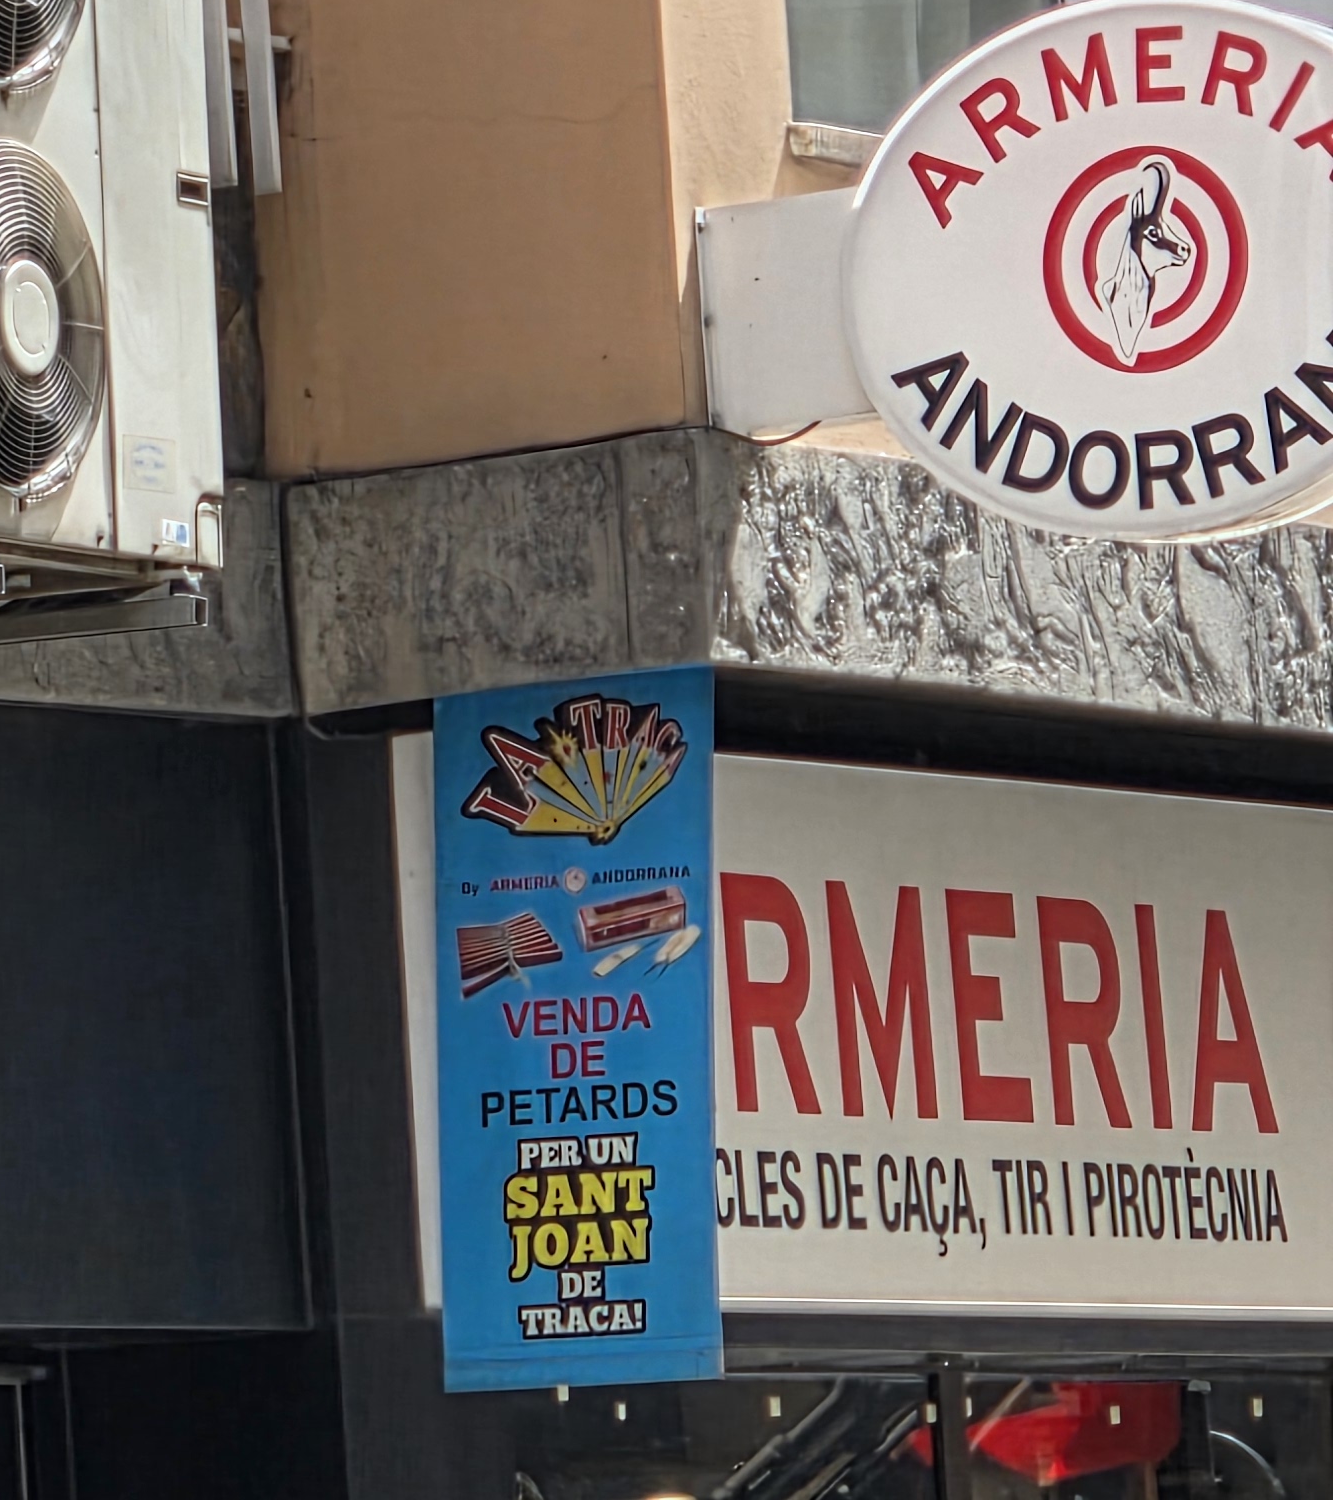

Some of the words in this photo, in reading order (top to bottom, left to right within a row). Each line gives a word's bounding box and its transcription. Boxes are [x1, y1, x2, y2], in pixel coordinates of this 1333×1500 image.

[490, 874, 560, 892] ARMERIA
[592, 865, 691, 884] ANDORRANA
[502, 993, 651, 1038] VENDA
[550, 1040, 606, 1079] DE
[481, 1080, 678, 1128] PETARDS
[520, 1139, 583, 1170] PER
[585, 1135, 636, 1165] UN
[505, 1168, 653, 1220] SANT
[816, 1152, 868, 1230] DE
[877, 1153, 987, 1257] CAÇA,
[992, 1159, 1053, 1236] TIR
[1061, 1160, 1074, 1237] I
[1083, 1148, 1288, 1242] PIROTÈCNIA
[510, 1217, 650, 1280] JOAN
[561, 1270, 602, 1299] DE
[521, 1303, 643, 1336] TRACA!
